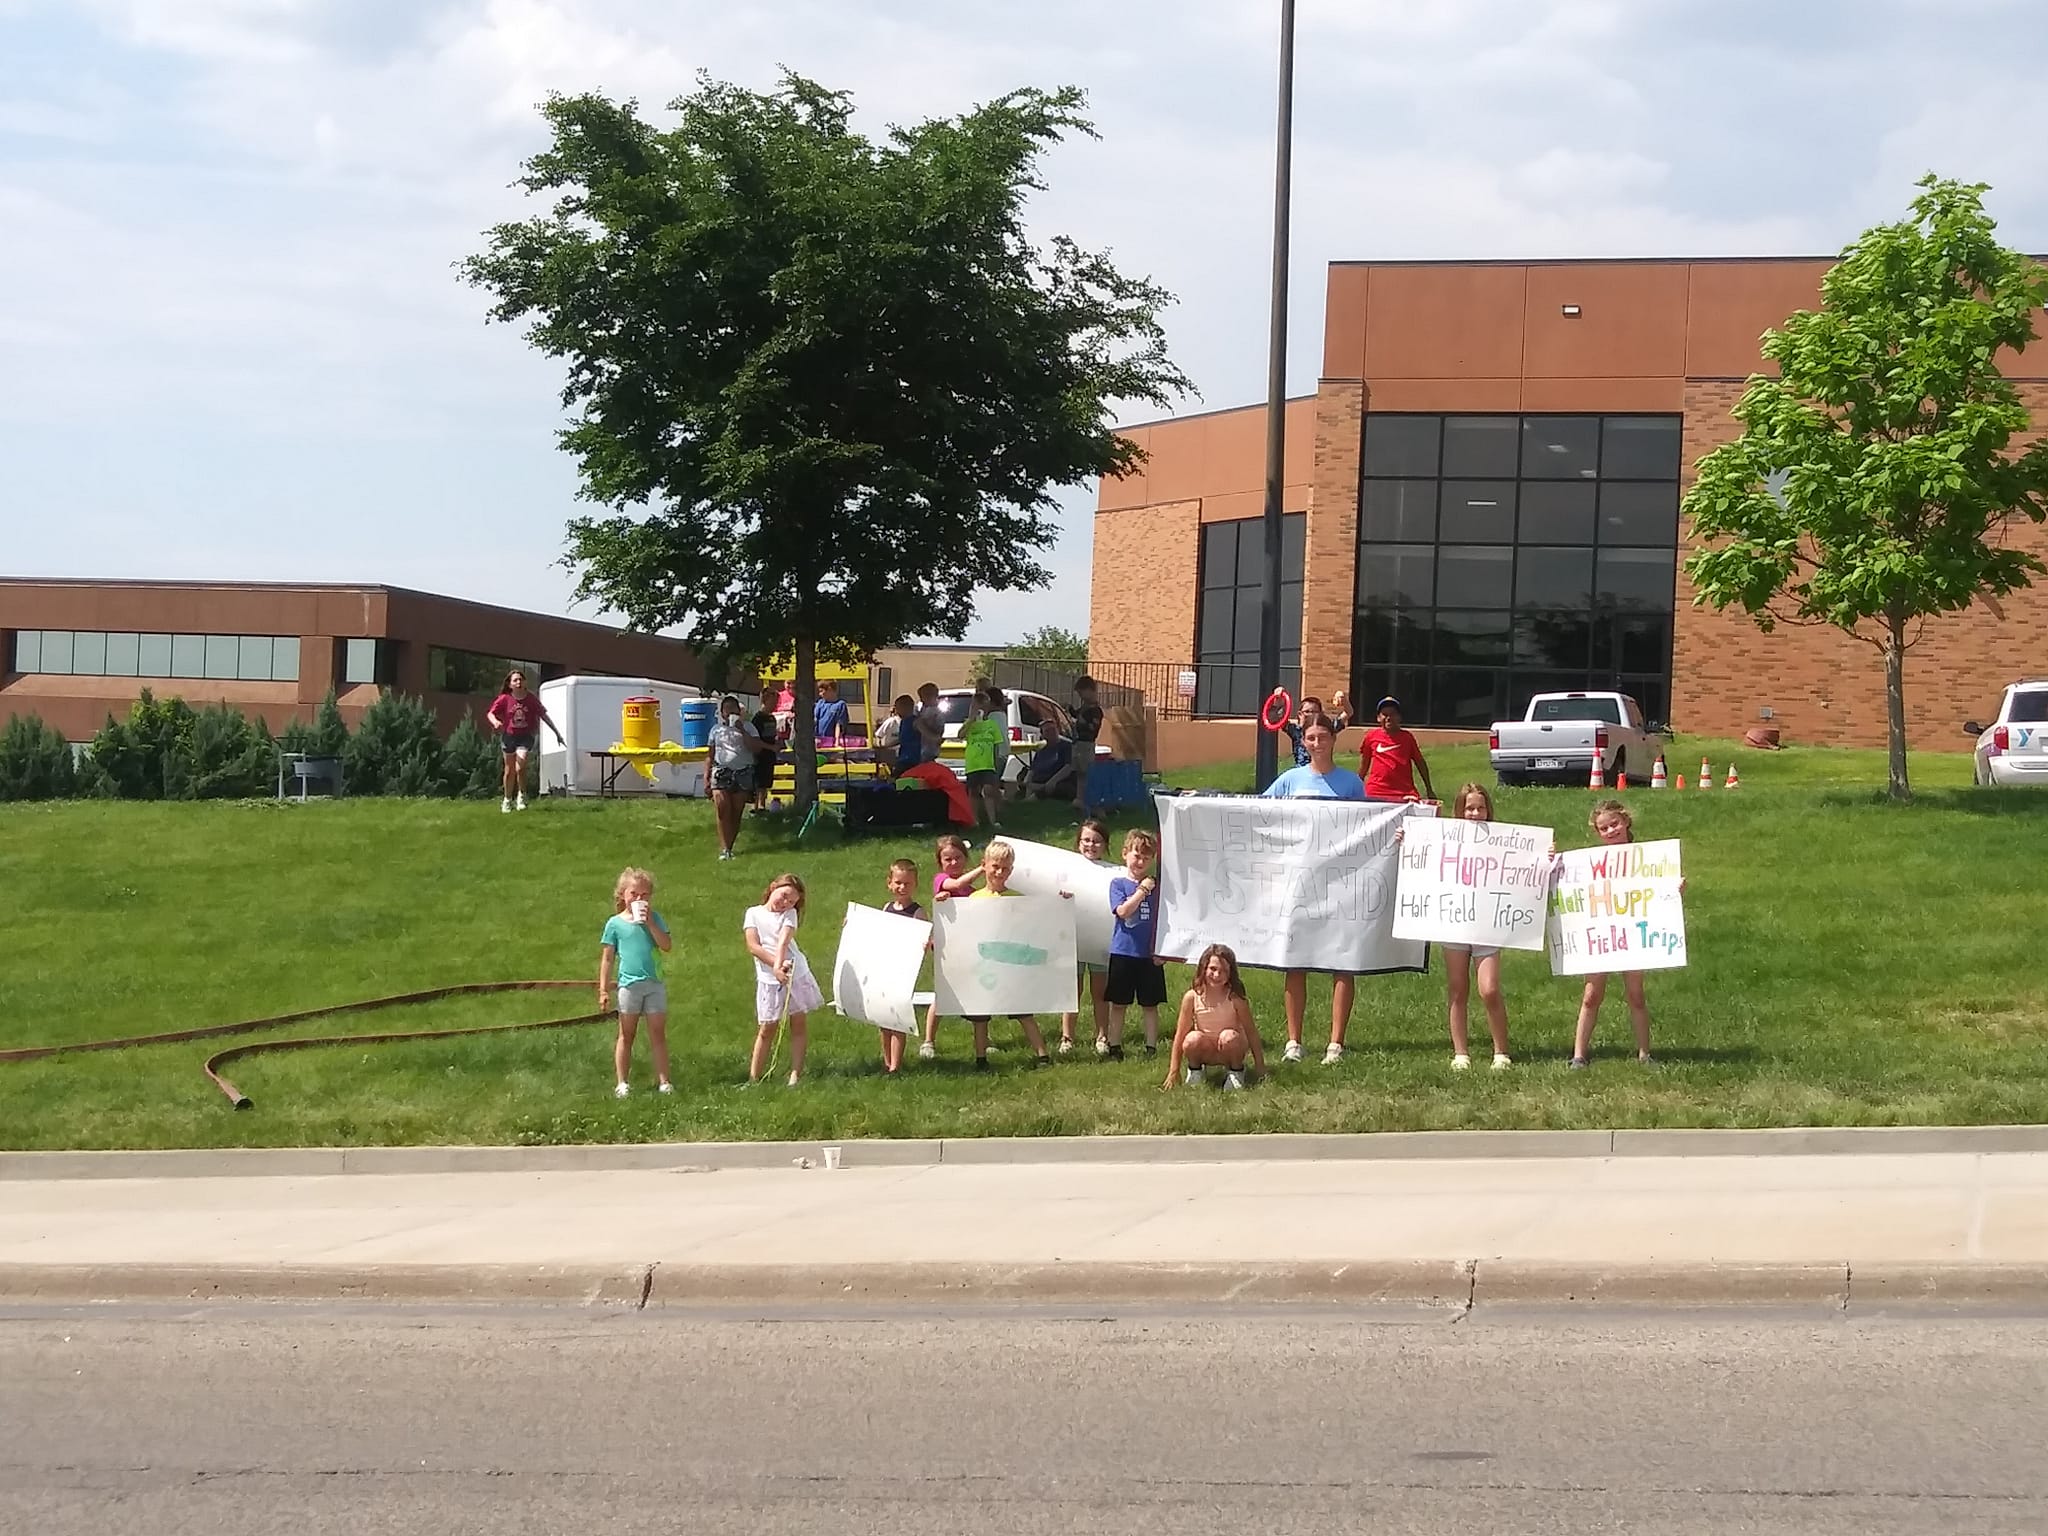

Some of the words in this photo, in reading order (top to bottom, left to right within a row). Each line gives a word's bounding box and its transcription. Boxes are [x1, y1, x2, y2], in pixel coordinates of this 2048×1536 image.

[1441, 821, 1465, 844] Will
[1474, 822, 1536, 852] Donation
[1402, 843, 1432, 870] Half
[1500, 851, 1549, 900] Family
[1590, 850, 1628, 880] Will
[1213, 857, 1389, 921] STAND
[1401, 894, 1431, 918] Half
[1440, 891, 1476, 923] Field
[1489, 891, 1535, 932] Trips
[1635, 920, 1684, 955] Trips
